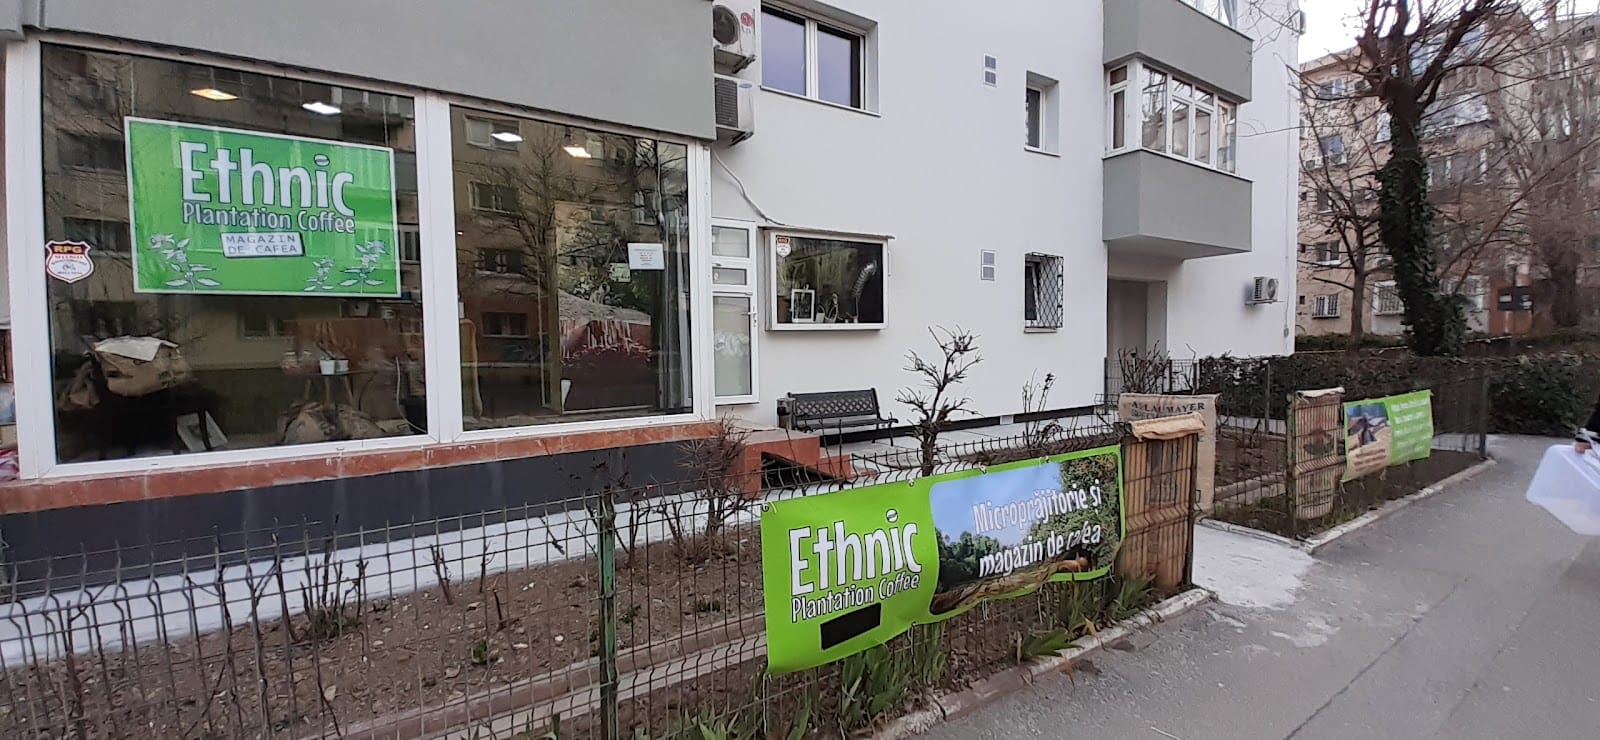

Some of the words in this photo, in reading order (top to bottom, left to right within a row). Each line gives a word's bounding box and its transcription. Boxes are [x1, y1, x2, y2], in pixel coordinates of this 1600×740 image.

[179, 141, 355, 218] Ethnic
[182, 202, 292, 230] Plantation
[297, 210, 356, 234] Coffee
[225, 234, 296, 245] MAGAZIN
[53, 245, 83, 254] RPG
[227, 244, 243, 254] DE
[255, 244, 298, 254] CAFEA
[973, 483, 1089, 534] Microprăjitorie
[788, 508, 923, 597] Ethnic
[978, 535, 1044, 579] magazin
[1046, 530, 1065, 558] de
[791, 583, 875, 624] Plantation
[878, 572, 921, 601] Coffee
